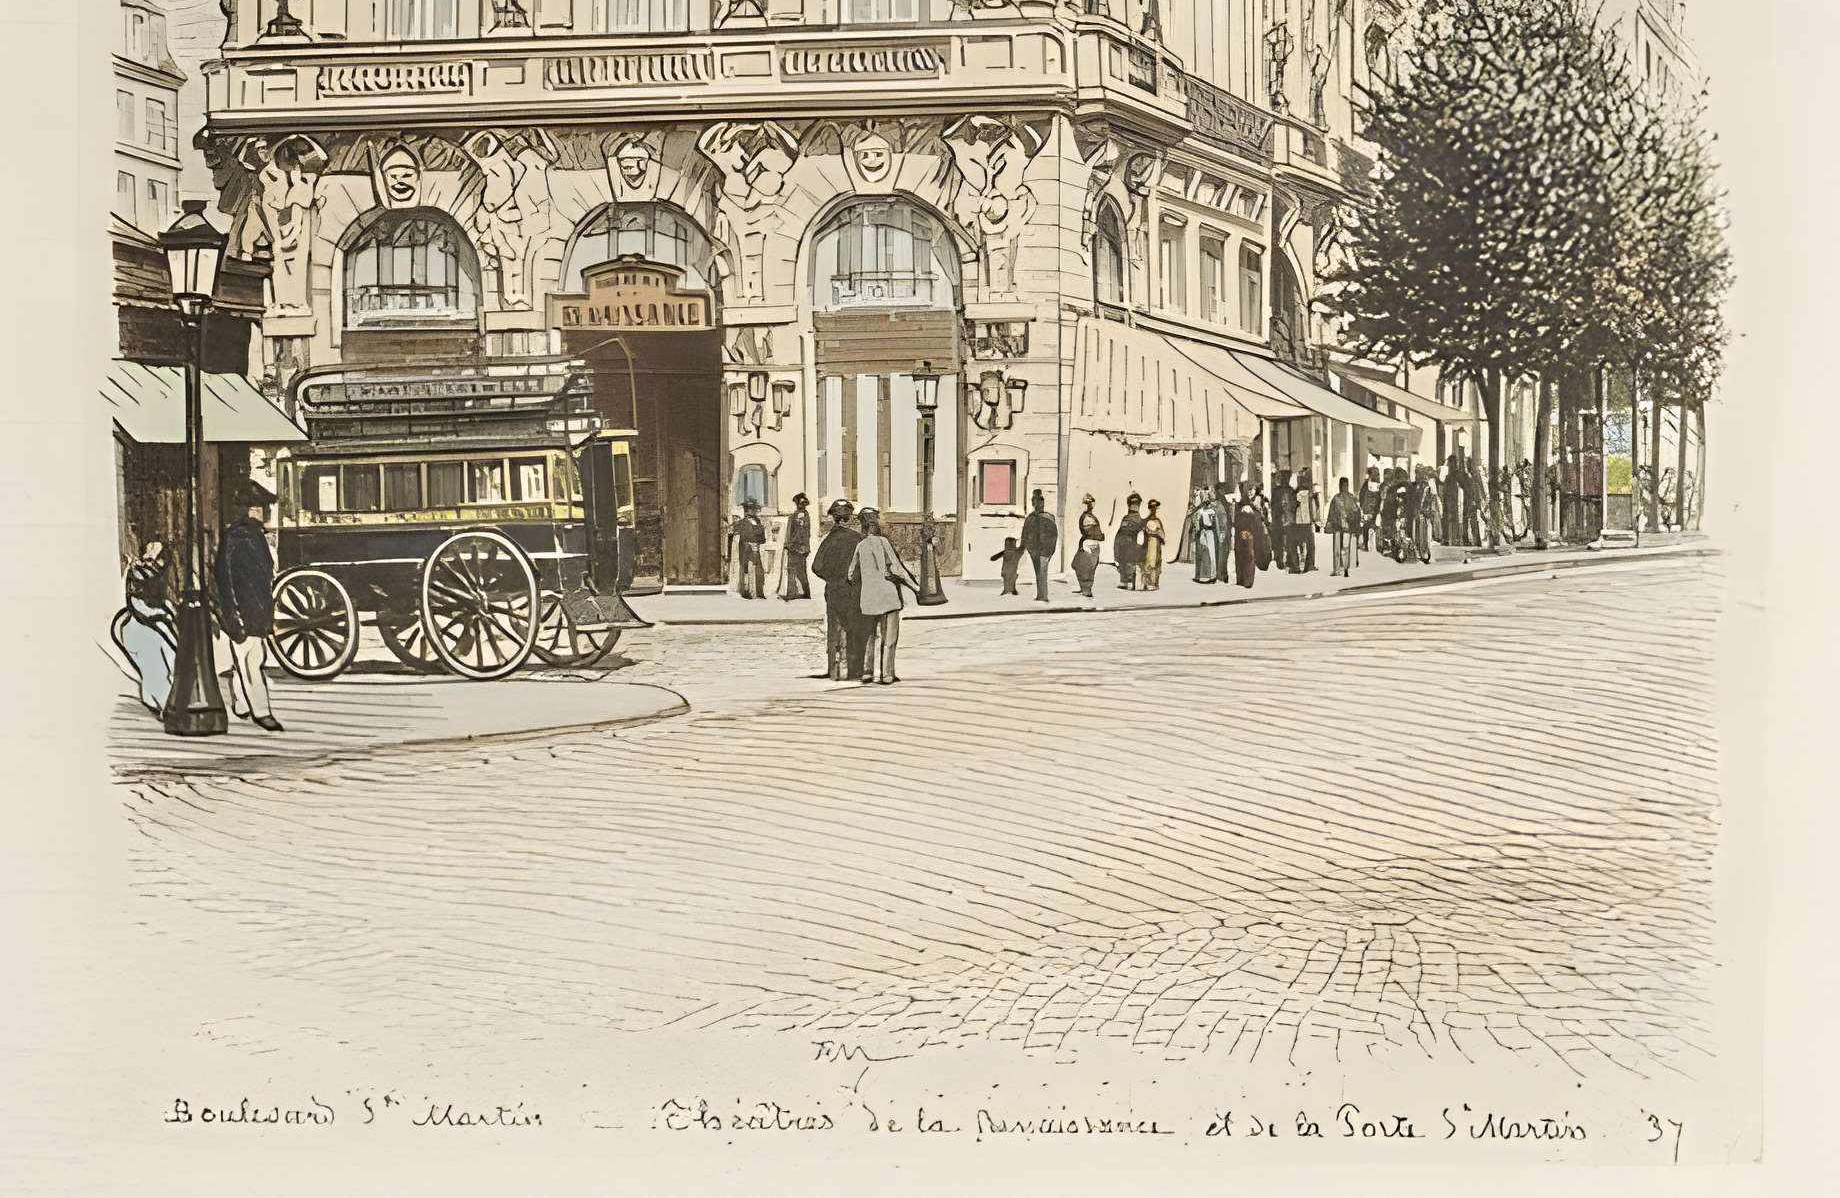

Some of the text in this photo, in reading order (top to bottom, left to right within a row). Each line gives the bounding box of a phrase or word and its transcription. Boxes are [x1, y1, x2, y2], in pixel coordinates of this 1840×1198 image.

[412, 1099, 545, 1127] Martin
[918, 1106, 961, 1133] la
[1336, 1103, 1426, 1139] Porte
